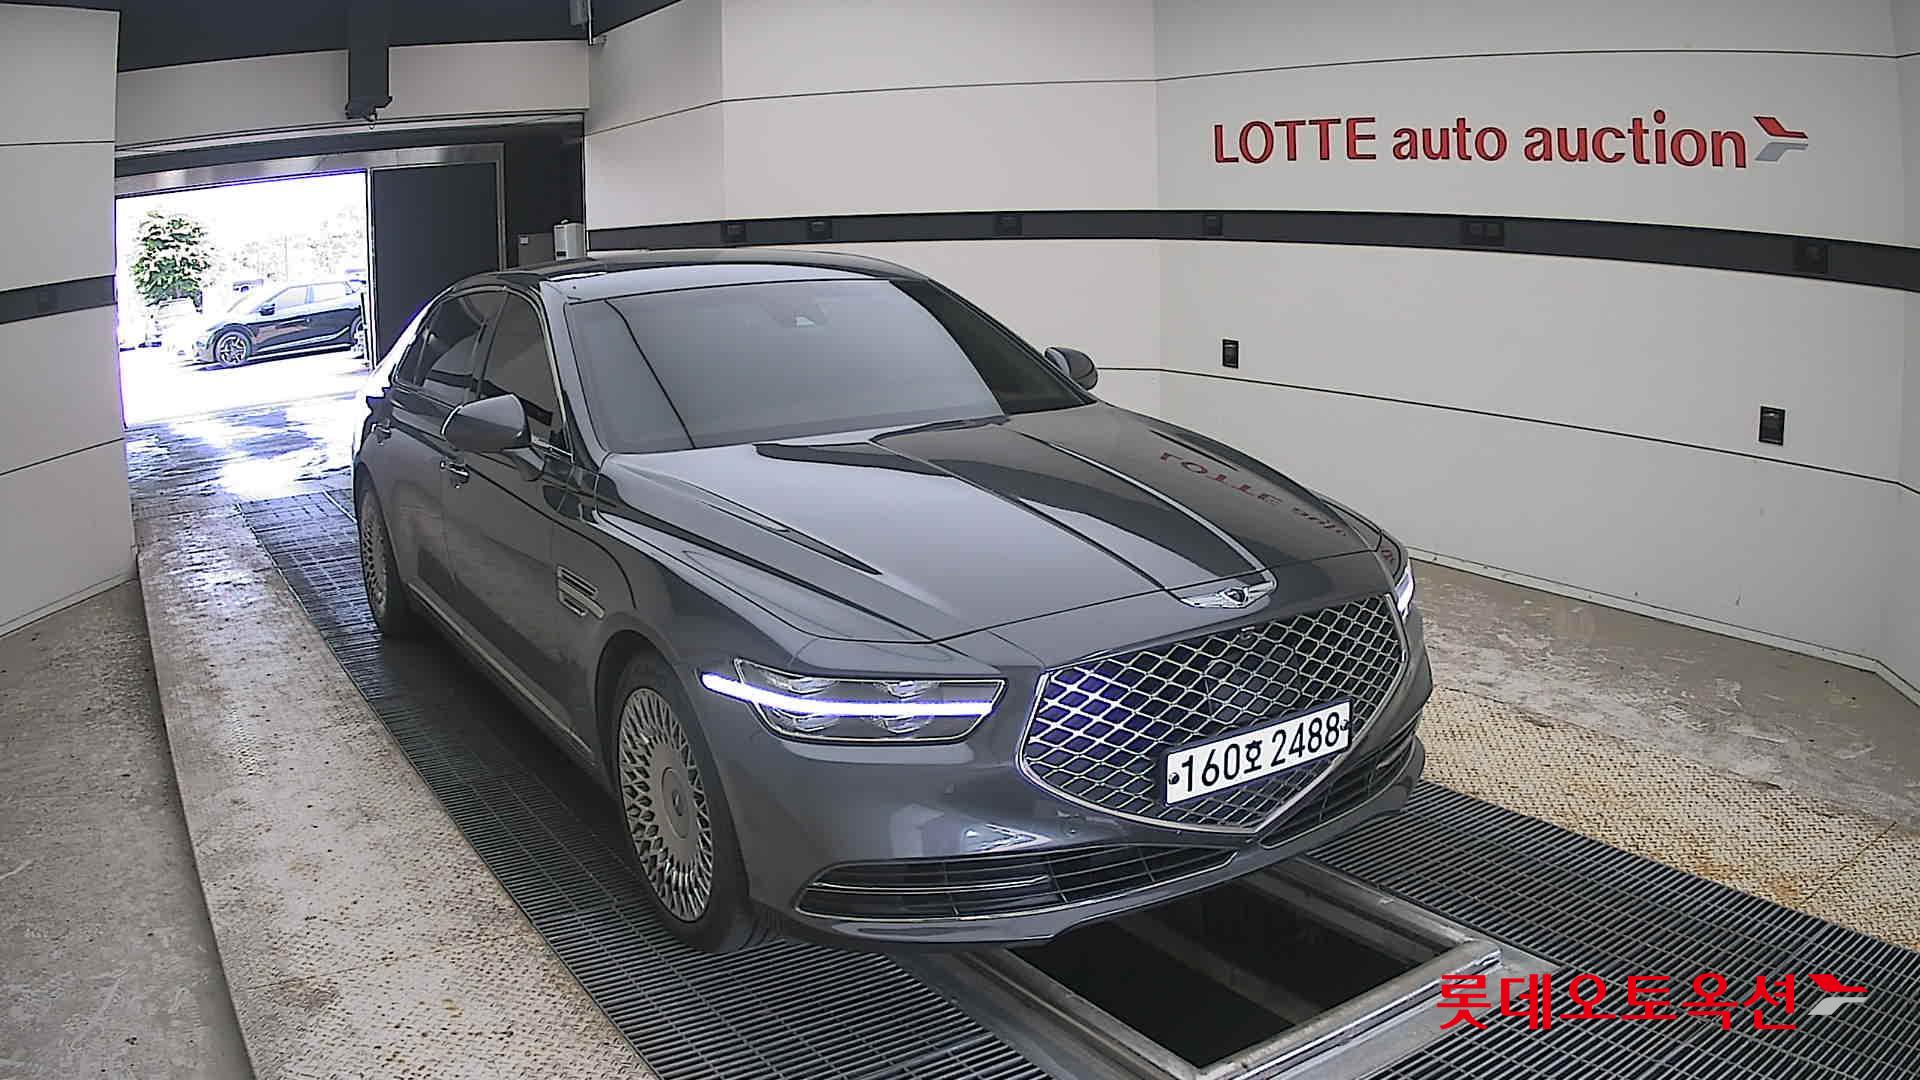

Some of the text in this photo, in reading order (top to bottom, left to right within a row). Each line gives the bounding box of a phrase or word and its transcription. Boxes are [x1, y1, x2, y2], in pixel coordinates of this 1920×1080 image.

[1213, 109, 1747, 168] LOTTE auto auction
[1181, 711, 1341, 792] 160호 2488
